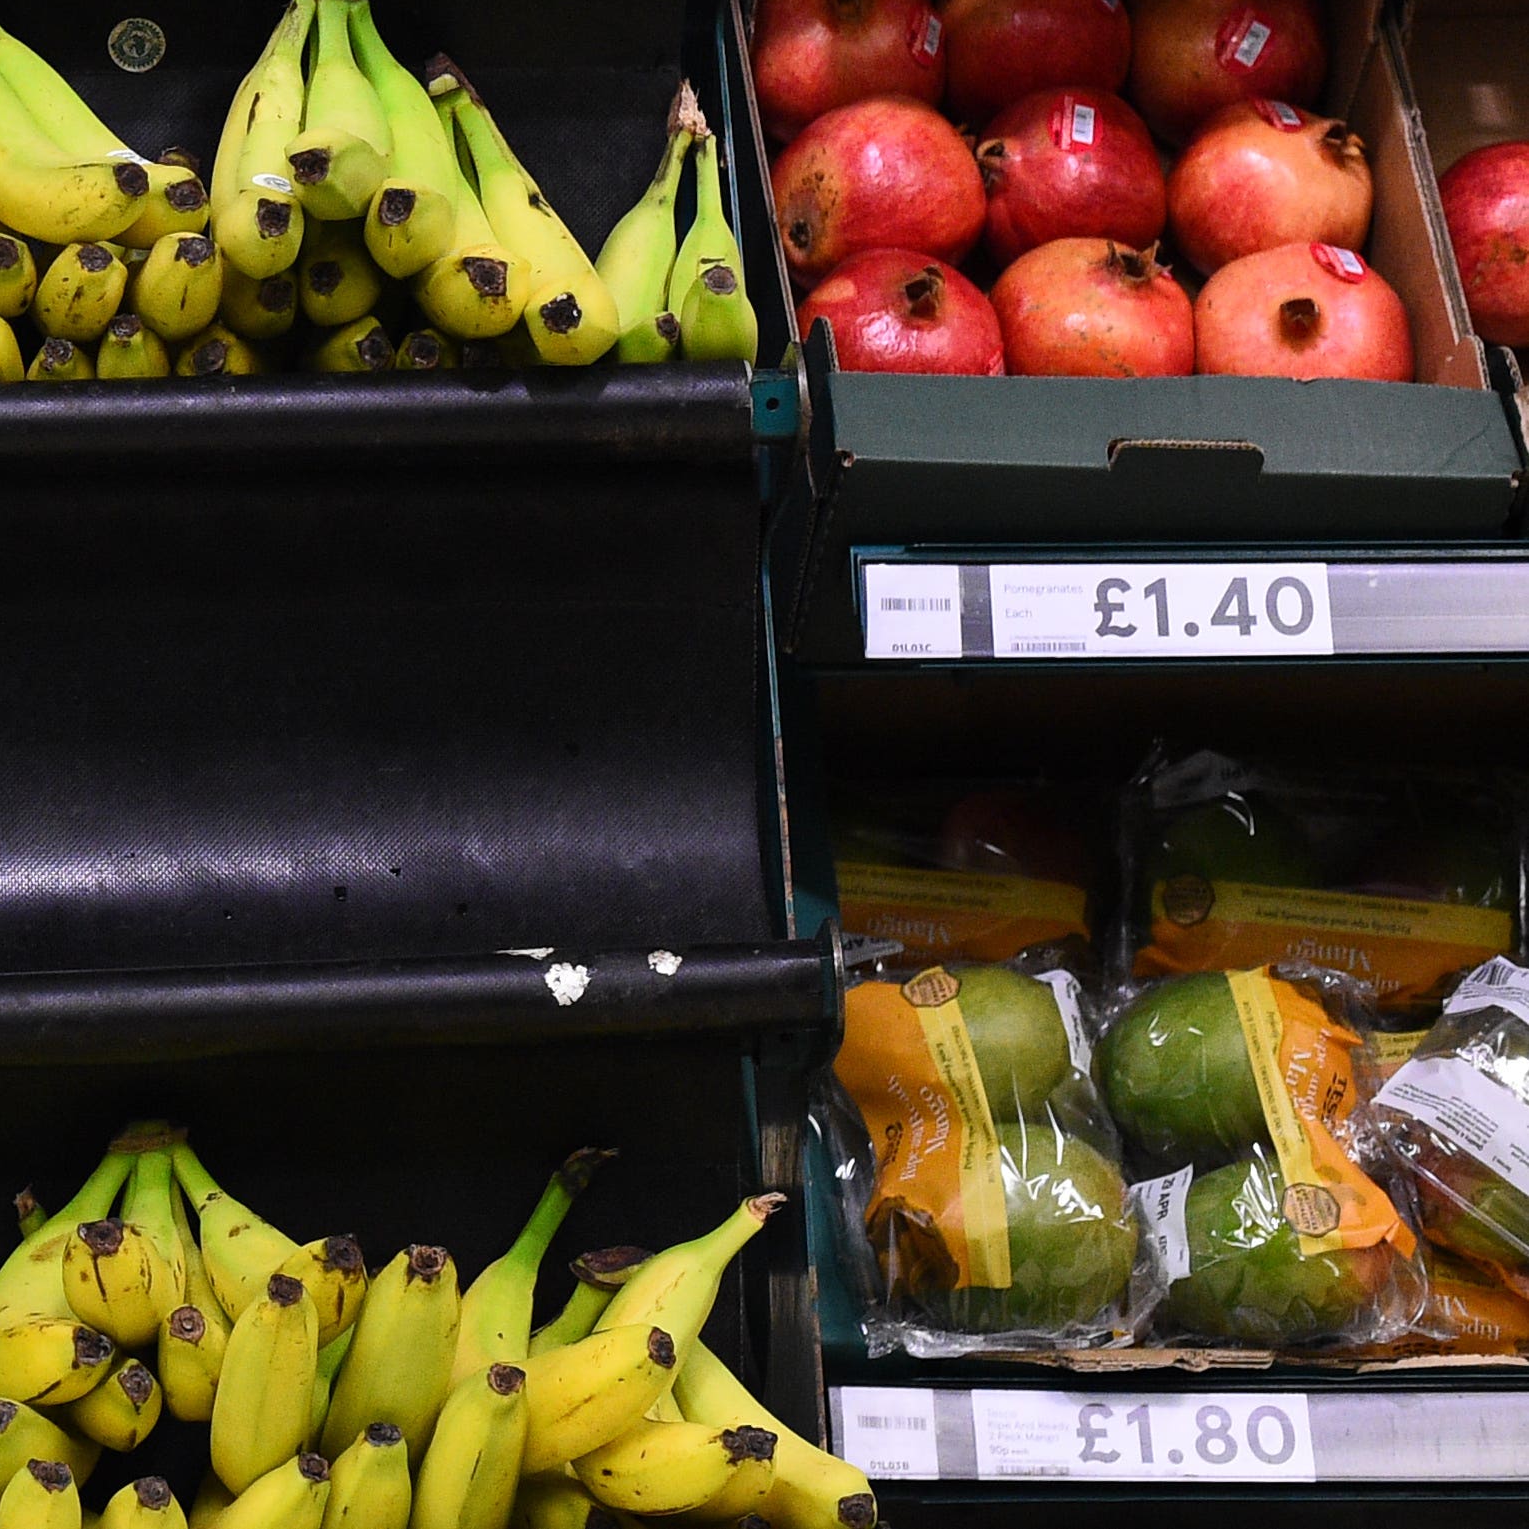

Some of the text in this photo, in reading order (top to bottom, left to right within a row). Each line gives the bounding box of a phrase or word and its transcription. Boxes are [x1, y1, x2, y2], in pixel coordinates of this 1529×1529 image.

[1003, 583, 1084, 596] Pomegranates
[1005, 607, 1033, 619] Each
[1093, 576, 1315, 637] £1.40
[1286, 938, 1371, 971] Mango
[918, 1085, 949, 1156] Mango
[1157, 1193, 1169, 1221] APR
[1075, 1402, 1296, 1465] £1.80
